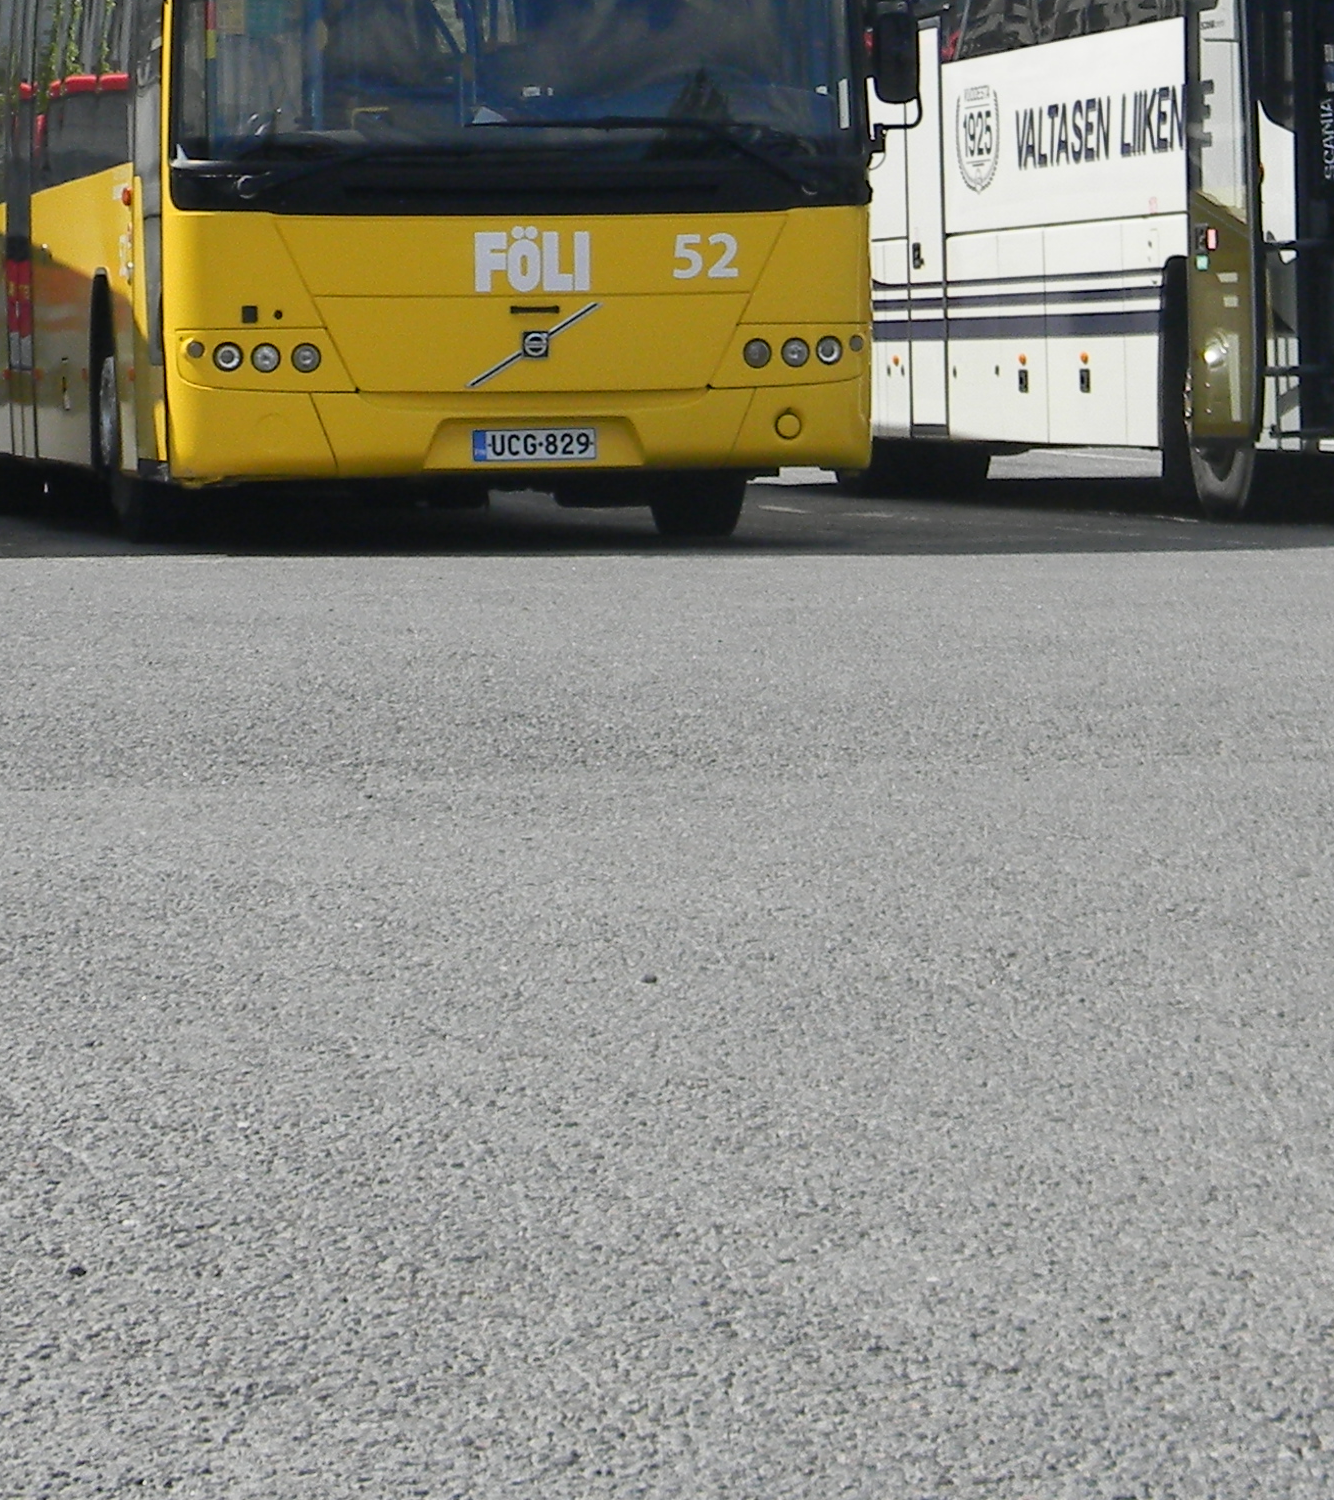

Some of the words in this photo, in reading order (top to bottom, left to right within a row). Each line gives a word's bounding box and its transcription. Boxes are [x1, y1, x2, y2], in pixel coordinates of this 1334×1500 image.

[963, 109, 993, 158] 1925
[1015, 95, 1111, 171] VALTASEN
[474, 226, 590, 293] FÖLI
[672, 232, 739, 279] 52
[490, 432, 590, 457] UCG-829
